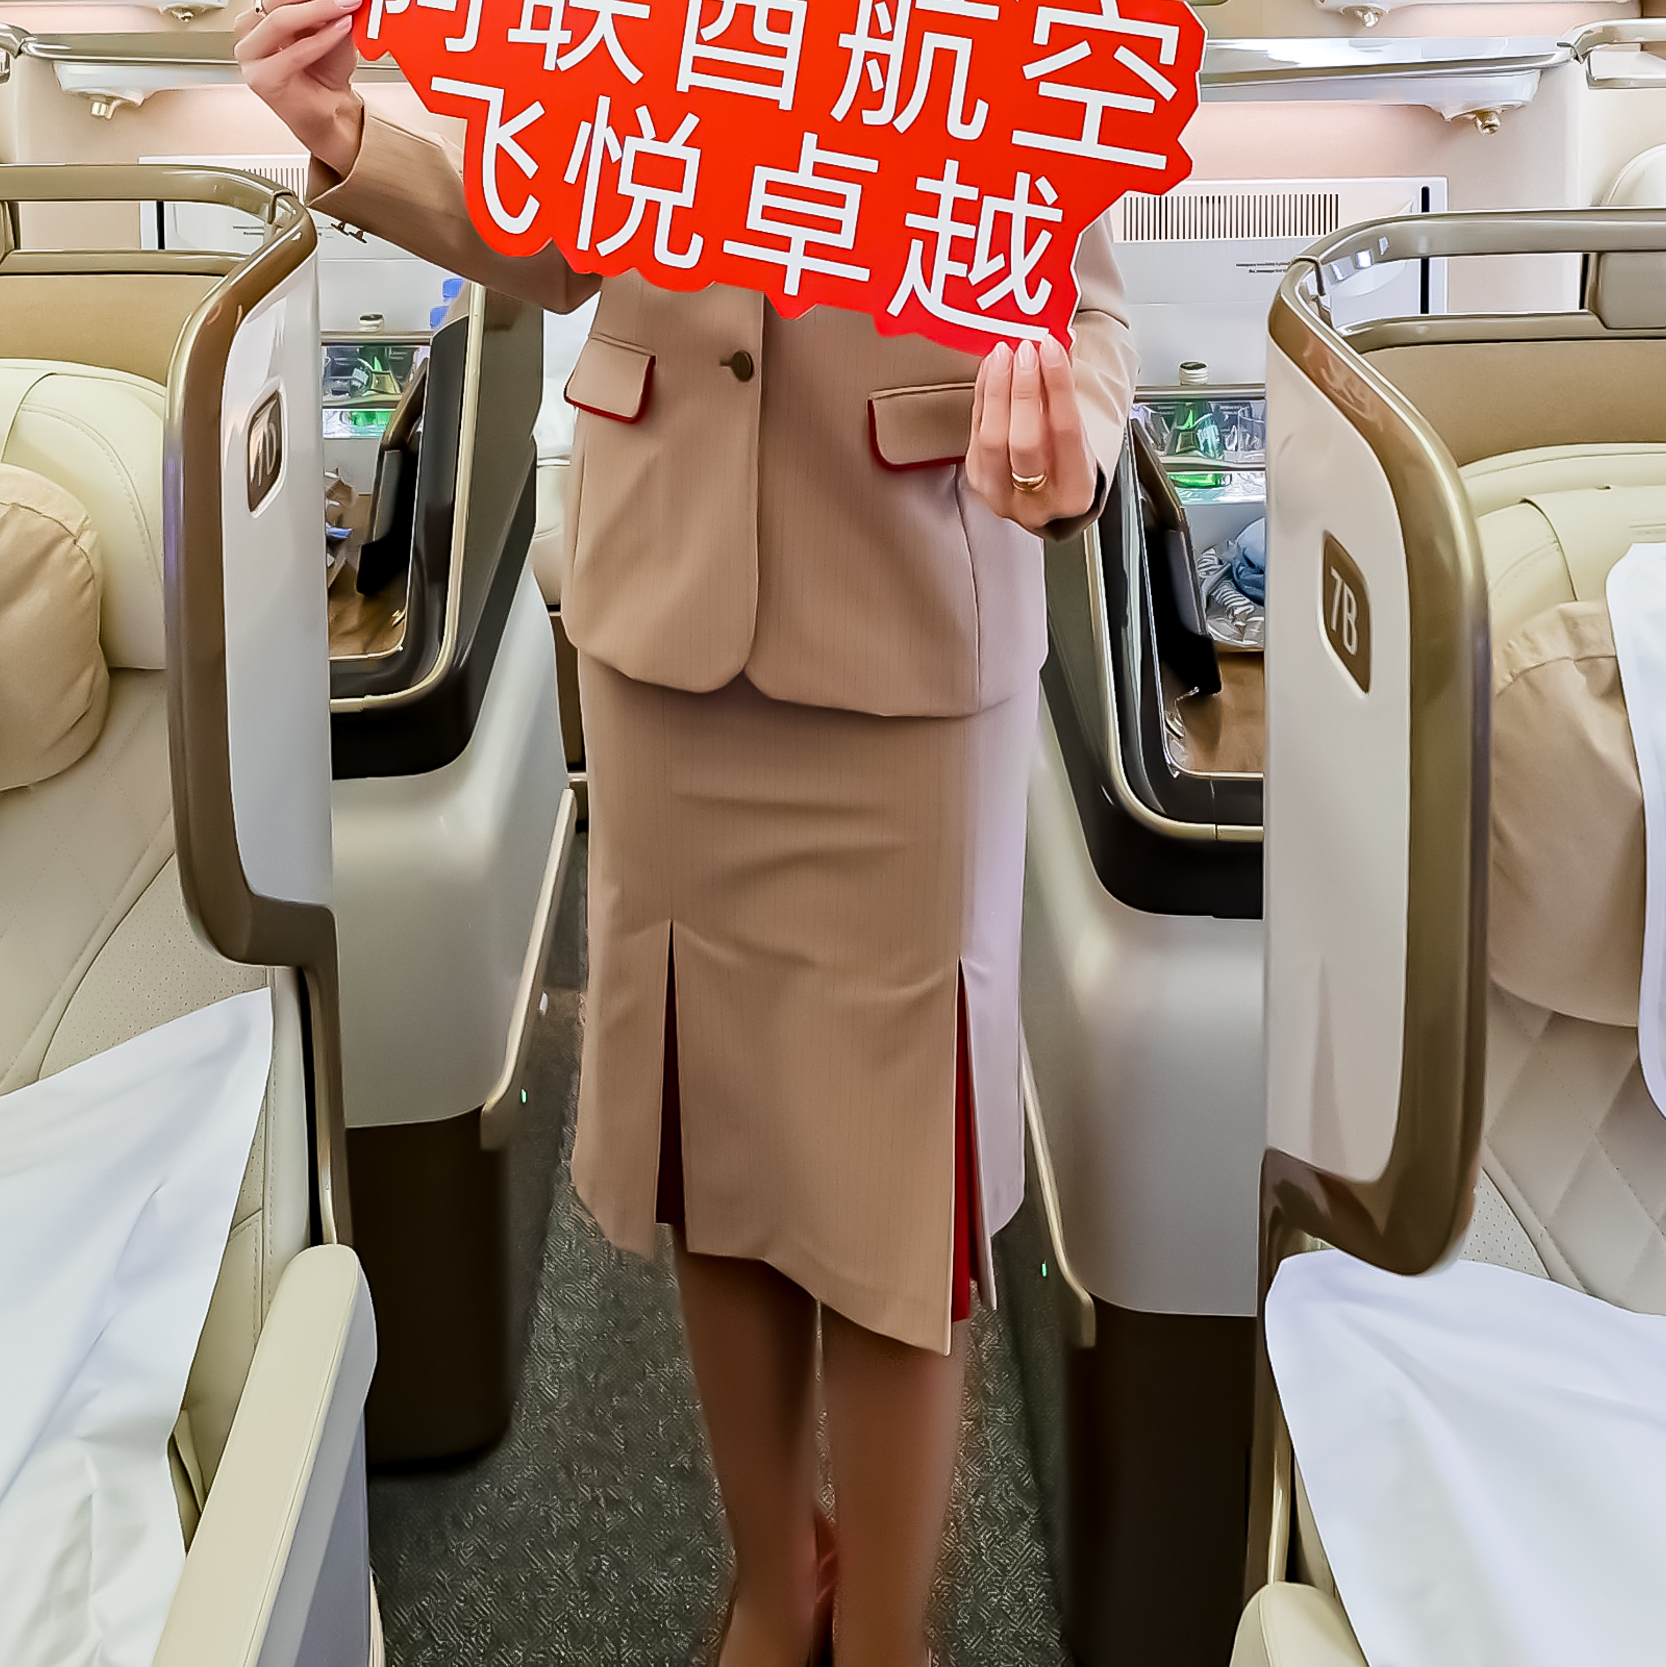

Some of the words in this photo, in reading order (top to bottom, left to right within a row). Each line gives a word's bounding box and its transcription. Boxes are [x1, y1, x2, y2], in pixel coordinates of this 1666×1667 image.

[431, 76, 1064, 339] 飞悦卓越
[1330, 564, 1358, 656] 7B
